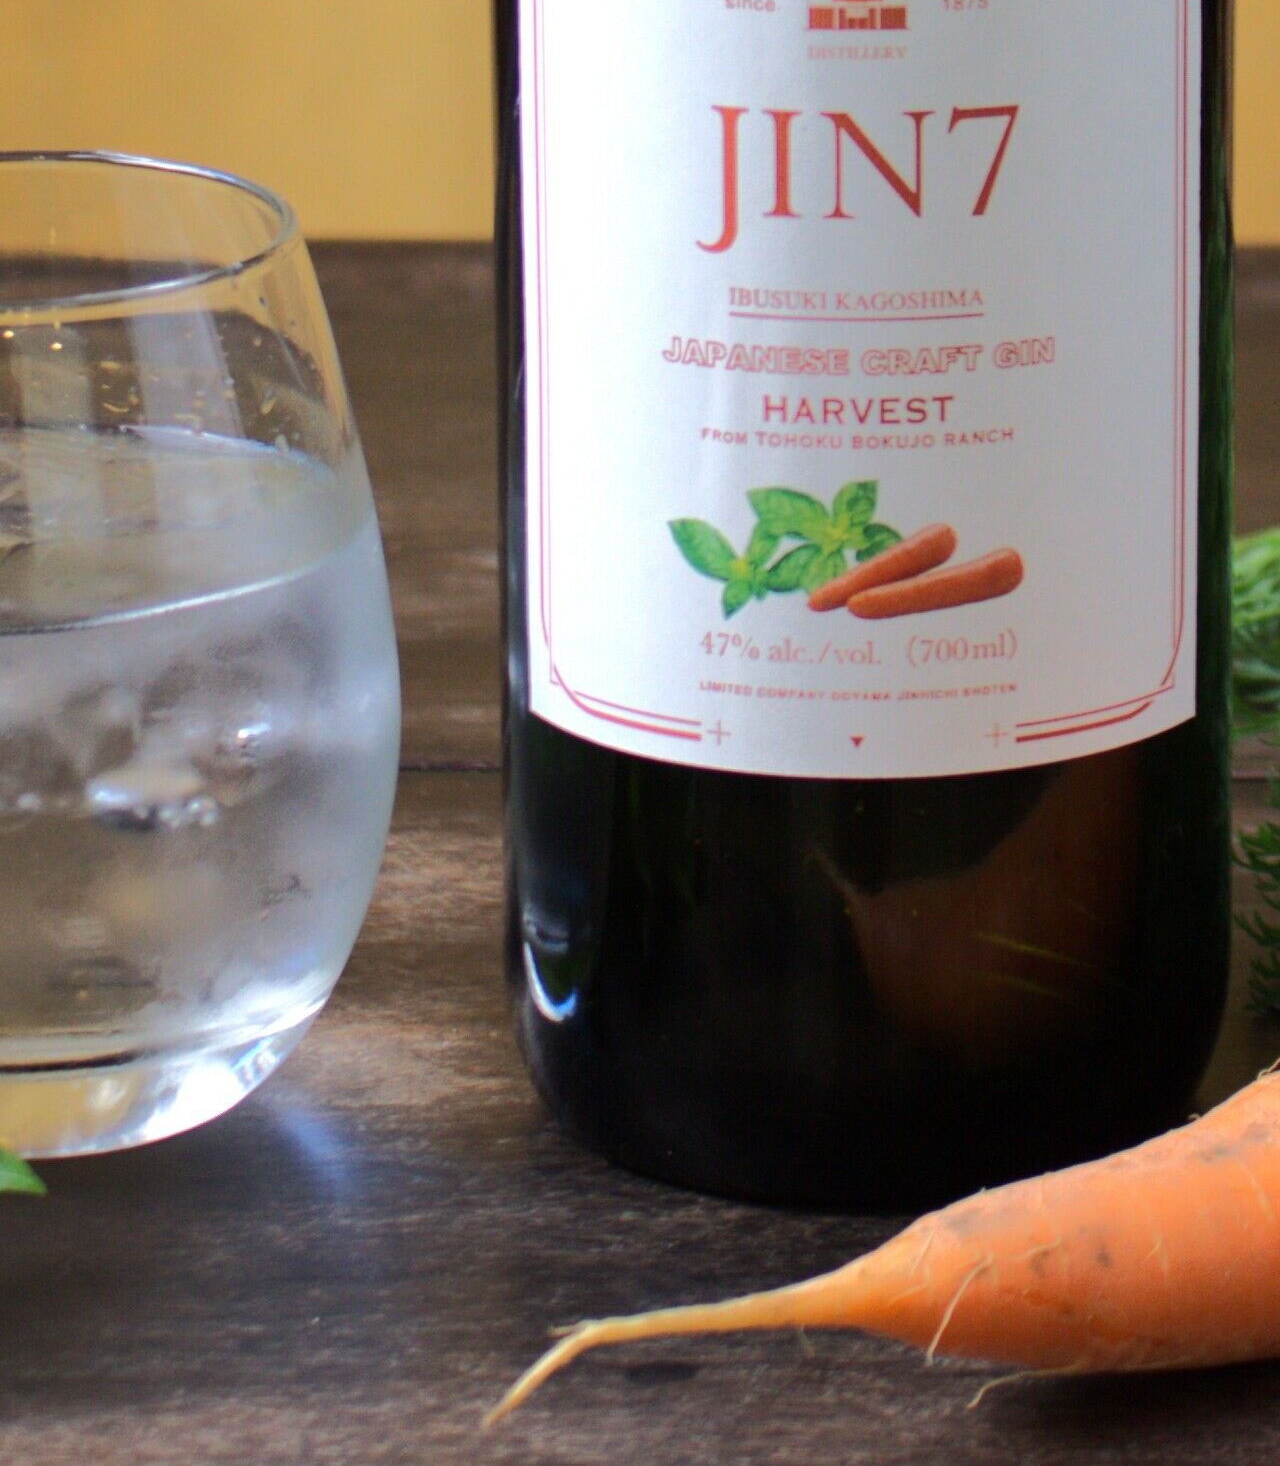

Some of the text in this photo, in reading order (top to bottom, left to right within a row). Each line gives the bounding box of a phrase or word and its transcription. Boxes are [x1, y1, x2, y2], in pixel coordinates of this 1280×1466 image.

[807, 45, 907, 59] DISTILLERY
[696, 103, 1019, 254] JIN7
[728, 286, 984, 310] IBUSUKI KAGOSHIMA
[662, 335, 1056, 376] JAPANESE CRAFT GIN
[762, 394, 954, 425] HARVEST
[700, 427, 1015, 451] FROM TOHOKU BOKUJO RANCH
[699, 630, 761, 662] 47%
[699, 680, 753, 696] LIMITED
[756, 686, 825, 700] COMPANY
